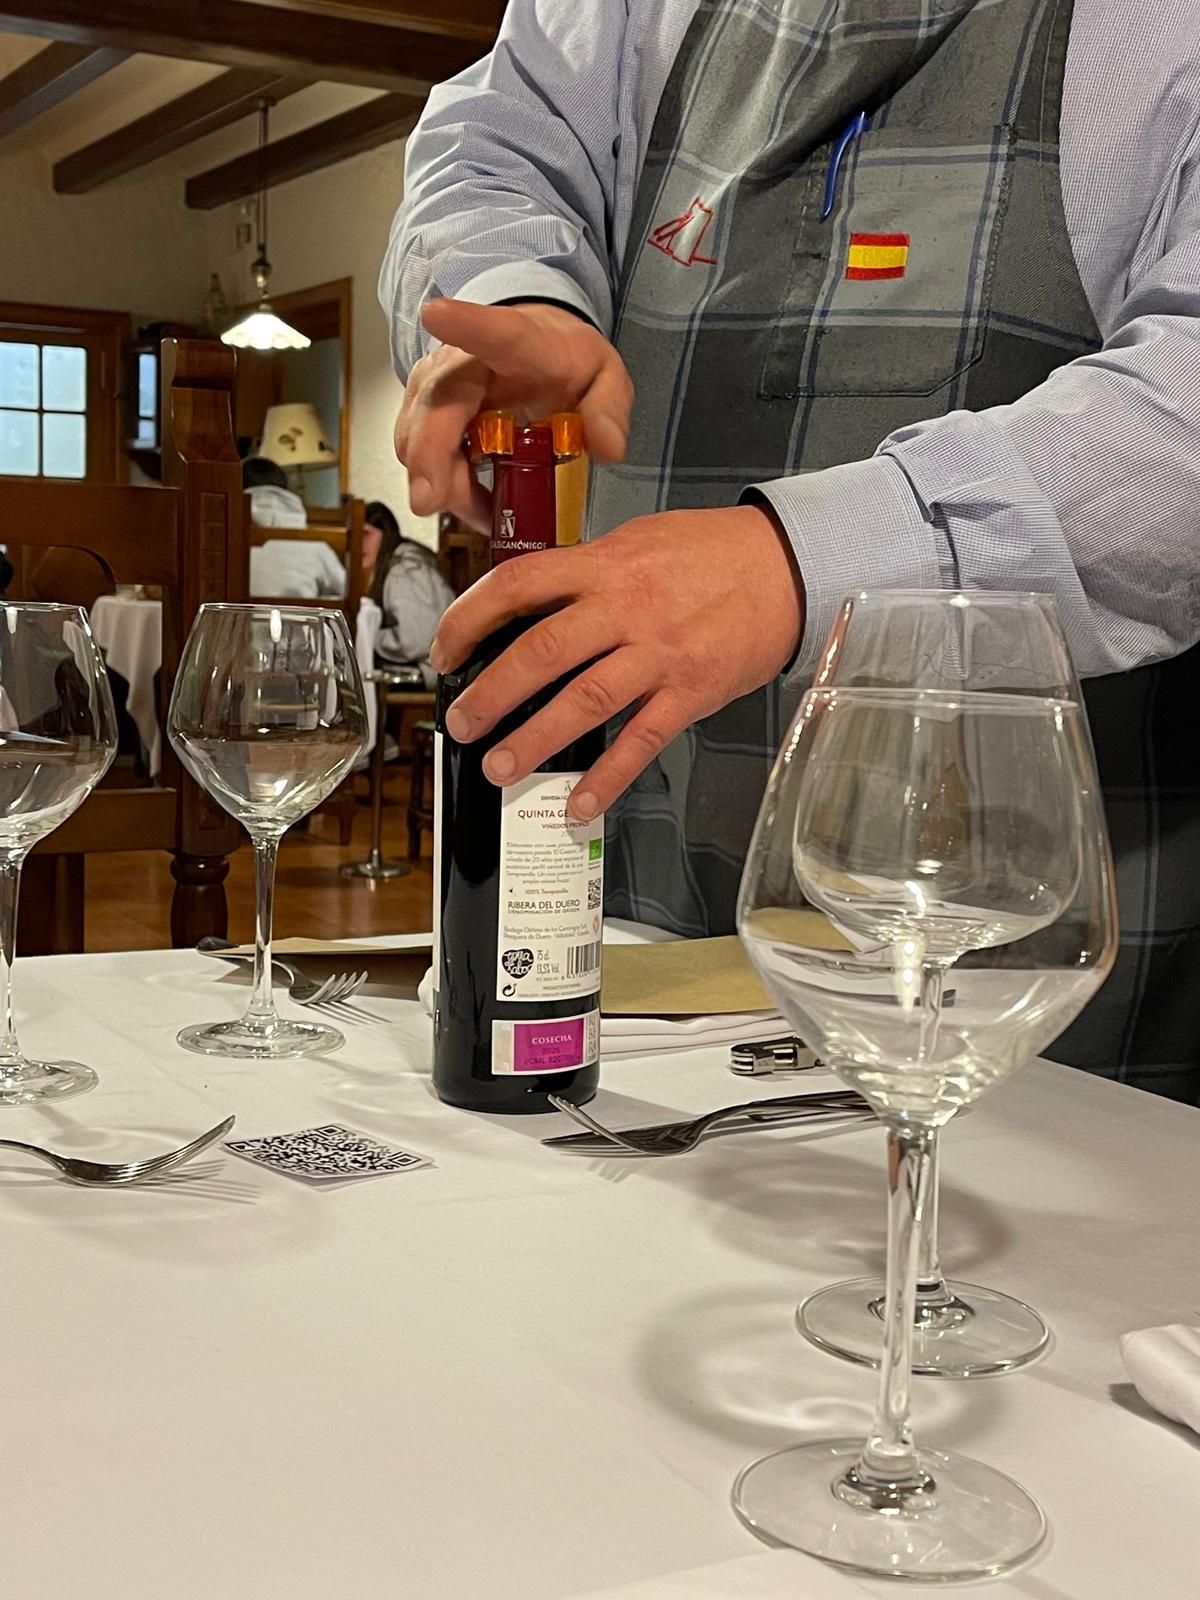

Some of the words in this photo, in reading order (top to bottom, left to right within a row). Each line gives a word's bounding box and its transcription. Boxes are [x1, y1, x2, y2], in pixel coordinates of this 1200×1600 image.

[517, 809, 556, 819] QUINTA
[508, 901, 537, 909] RIBERA
[539, 900, 554, 909] DEL
[555, 899, 581, 909] DUERO
[531, 1034, 572, 1045] COSECHA
